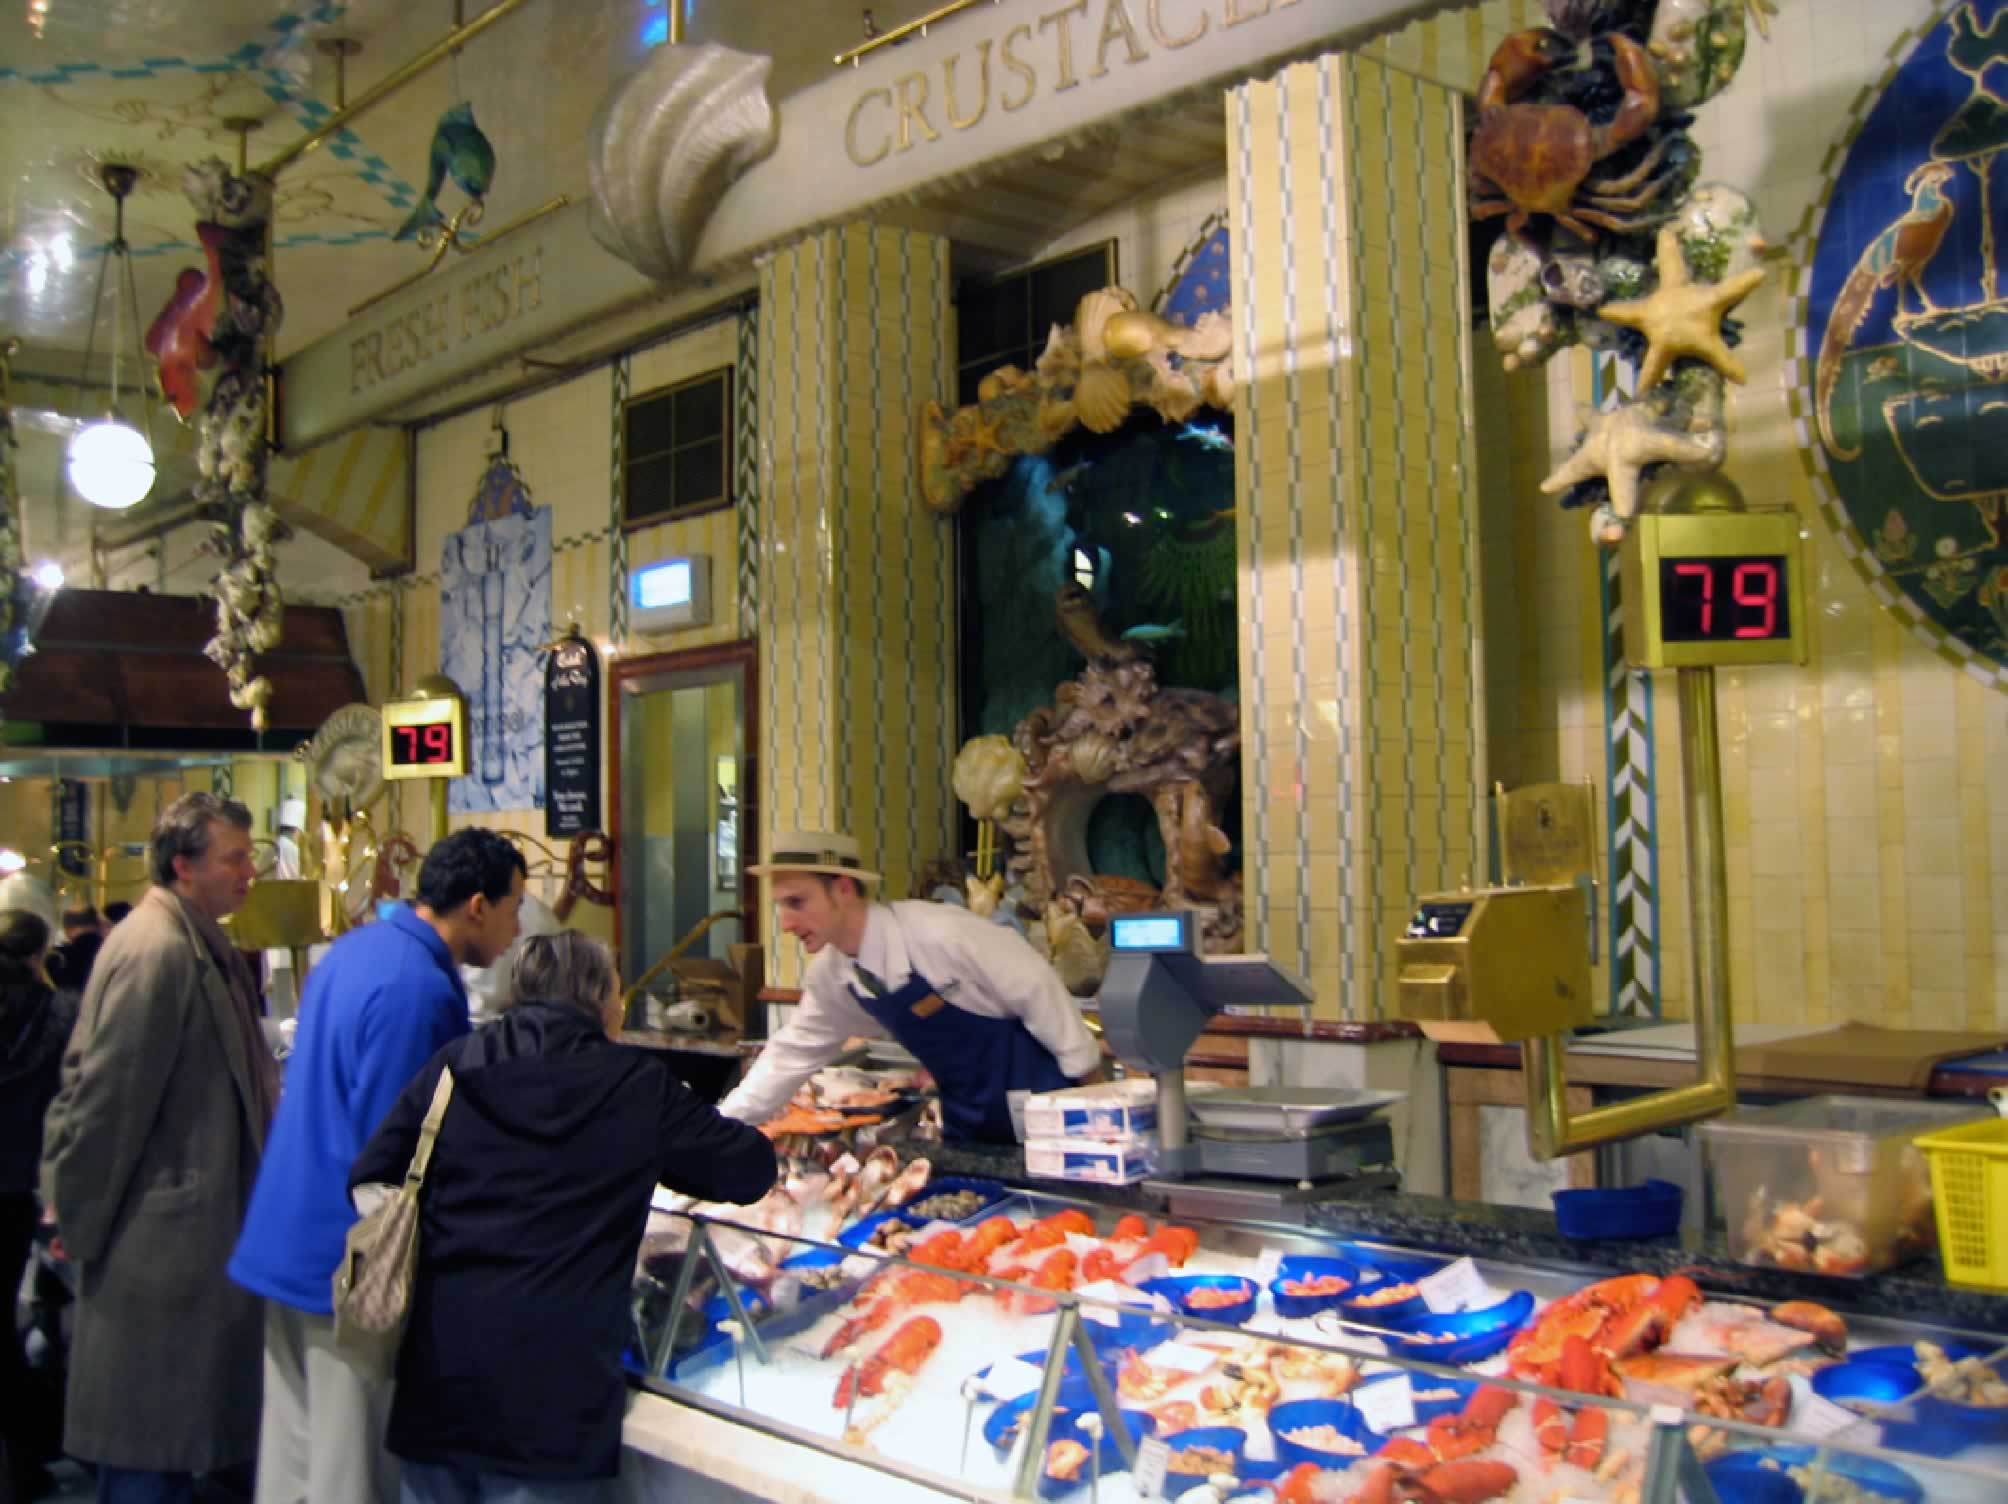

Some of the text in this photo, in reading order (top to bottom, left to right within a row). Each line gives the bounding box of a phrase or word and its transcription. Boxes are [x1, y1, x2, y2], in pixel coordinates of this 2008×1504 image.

[846, 0, 1297, 167] CRUSTAC
[351, 246, 544, 394] FRESH FISH
[1675, 563, 1776, 637] 79
[398, 725, 448, 763] 79
